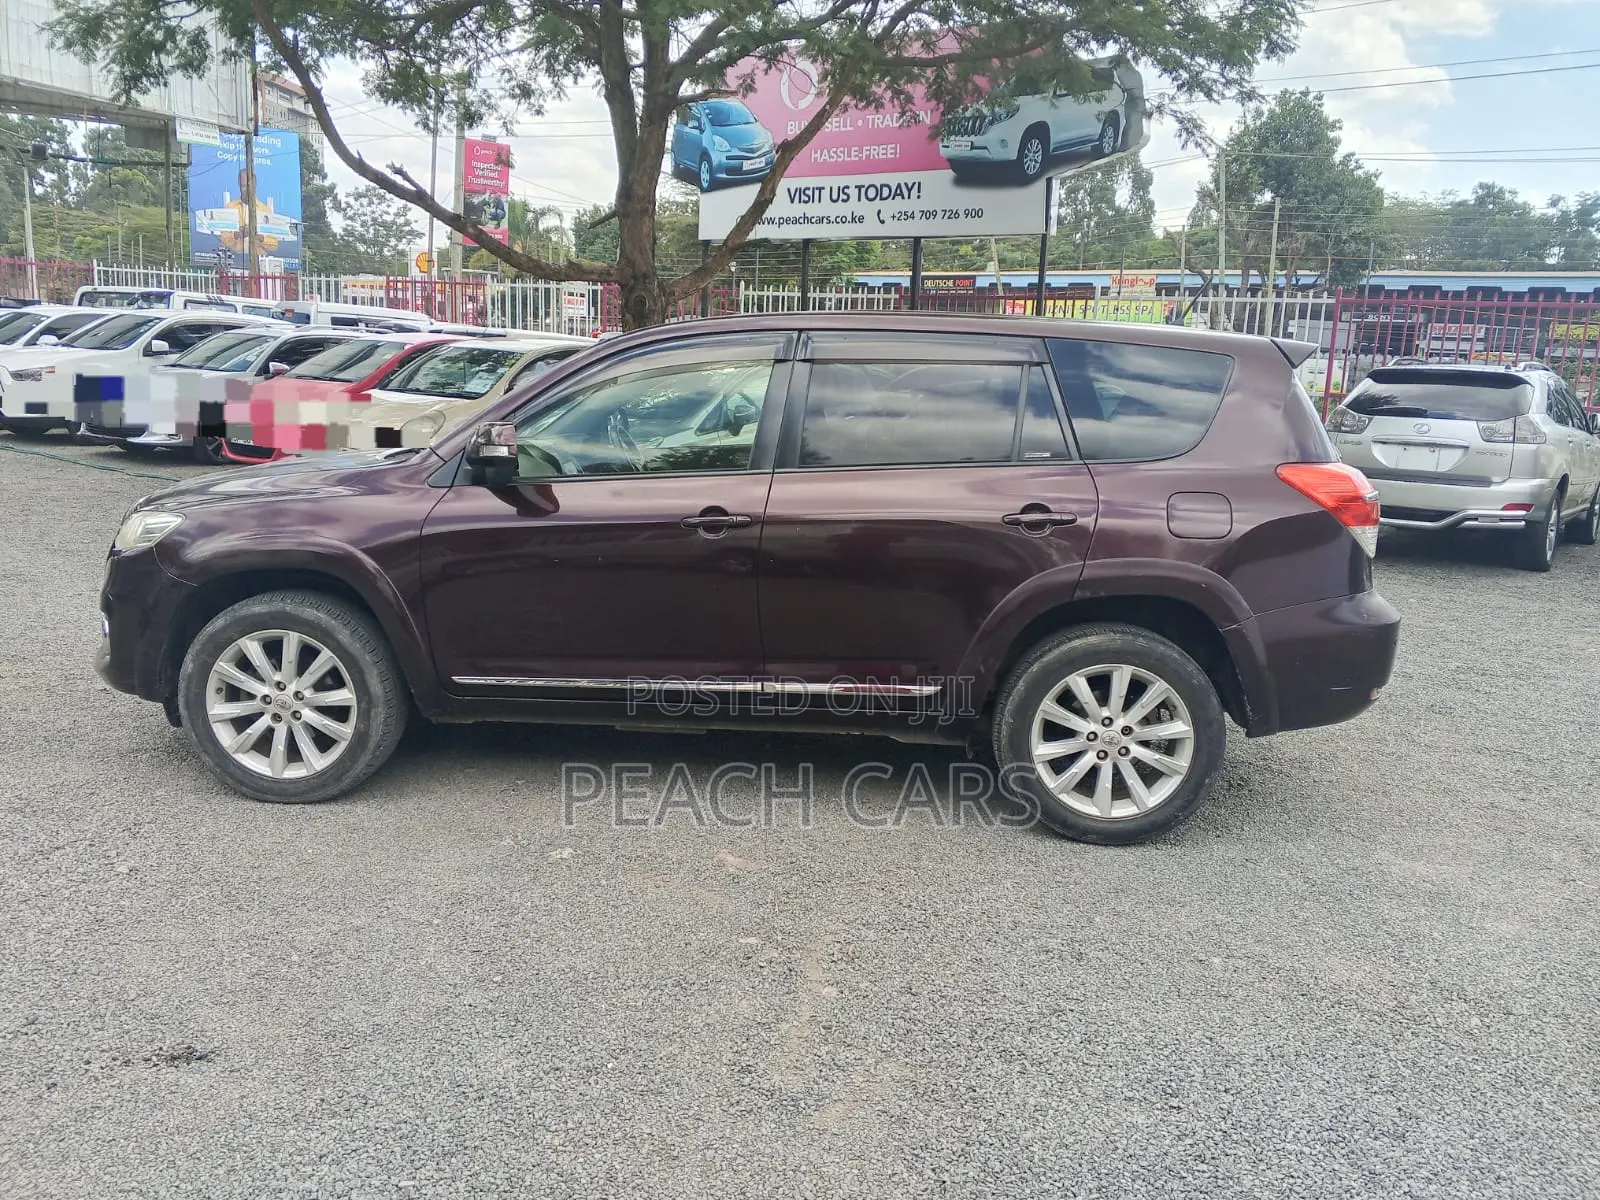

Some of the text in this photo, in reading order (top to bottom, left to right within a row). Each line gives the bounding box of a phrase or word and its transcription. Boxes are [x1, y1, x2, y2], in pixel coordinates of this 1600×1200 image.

[824, 115, 854, 132] SELL
[252, 135, 282, 148] rading
[217, 150, 238, 161] Copy
[811, 143, 900, 163] HASSLE-FREE!
[474, 168, 500, 179] Verified.
[787, 181, 922, 204] VISIT US TODAY!
[756, 207, 984, 228] ww.peachcars.co.ke +254 709 726 900
[923, 279, 974, 287] DEUTSCHE POINT
